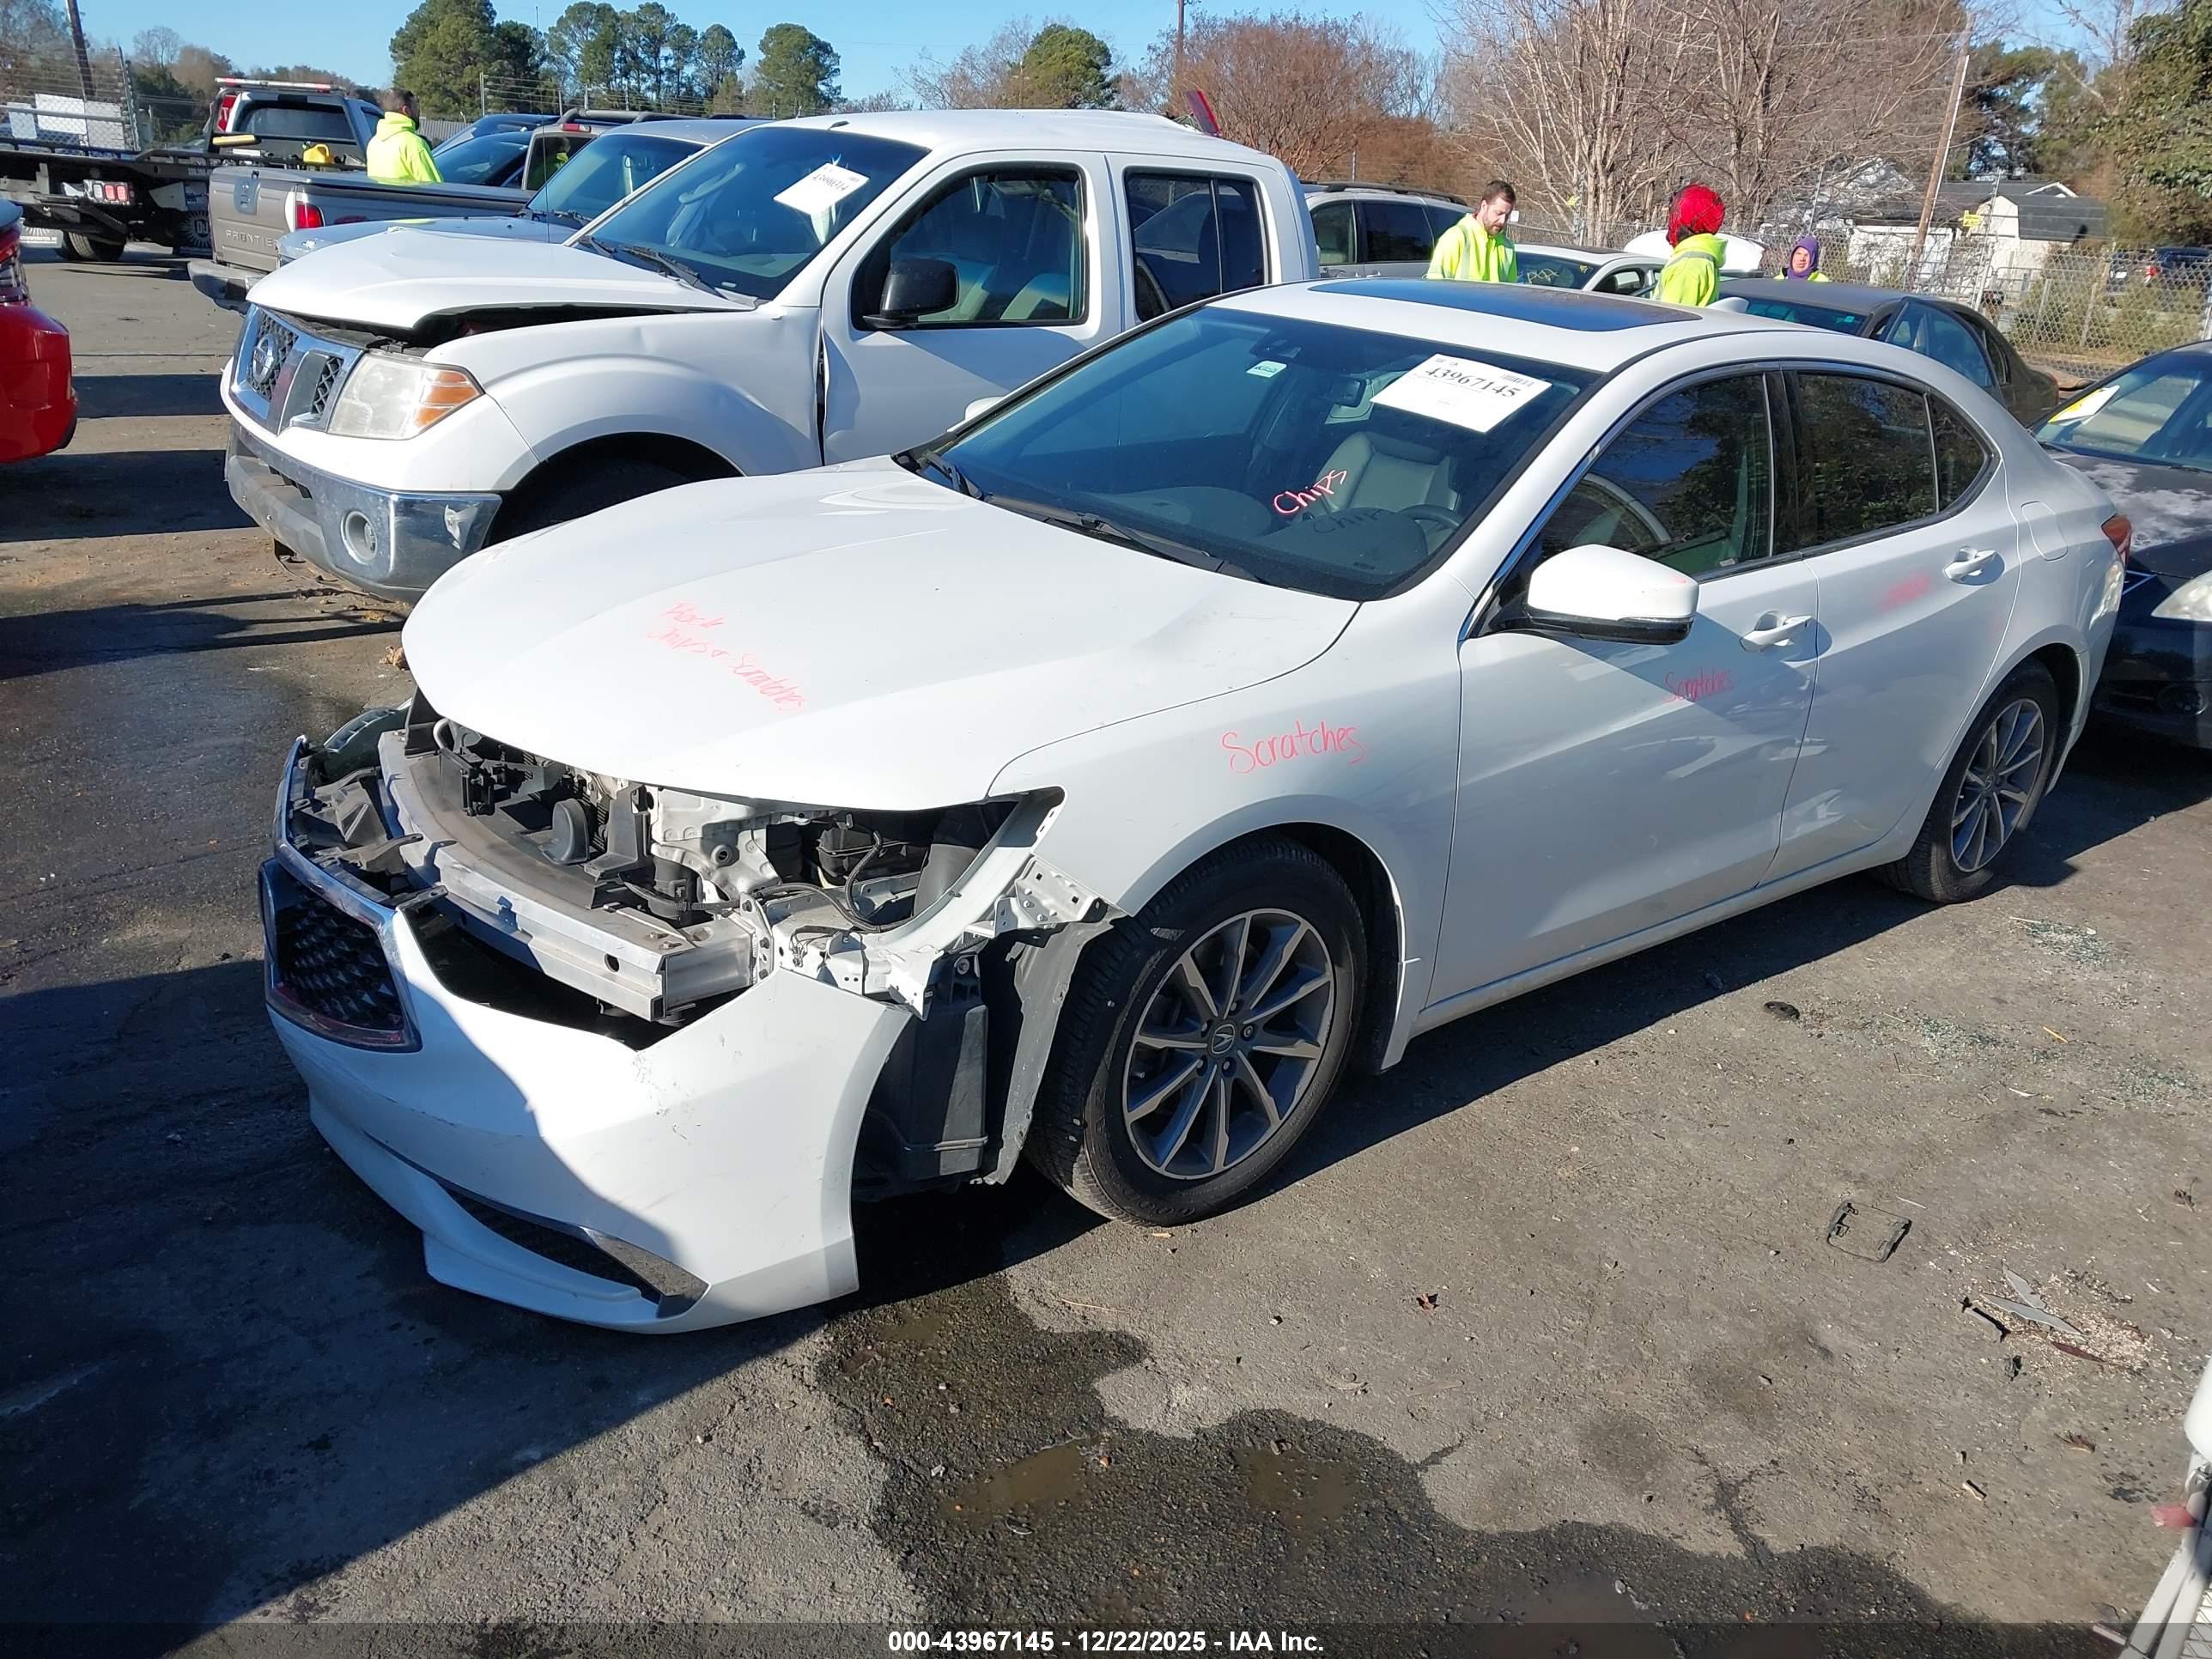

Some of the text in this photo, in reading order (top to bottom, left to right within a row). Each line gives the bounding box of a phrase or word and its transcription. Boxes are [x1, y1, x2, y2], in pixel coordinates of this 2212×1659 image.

[226, 229, 276, 248] FRONTIE
[1425, 367, 1521, 398] 43967145
[1222, 720, 1366, 775] Scratches
